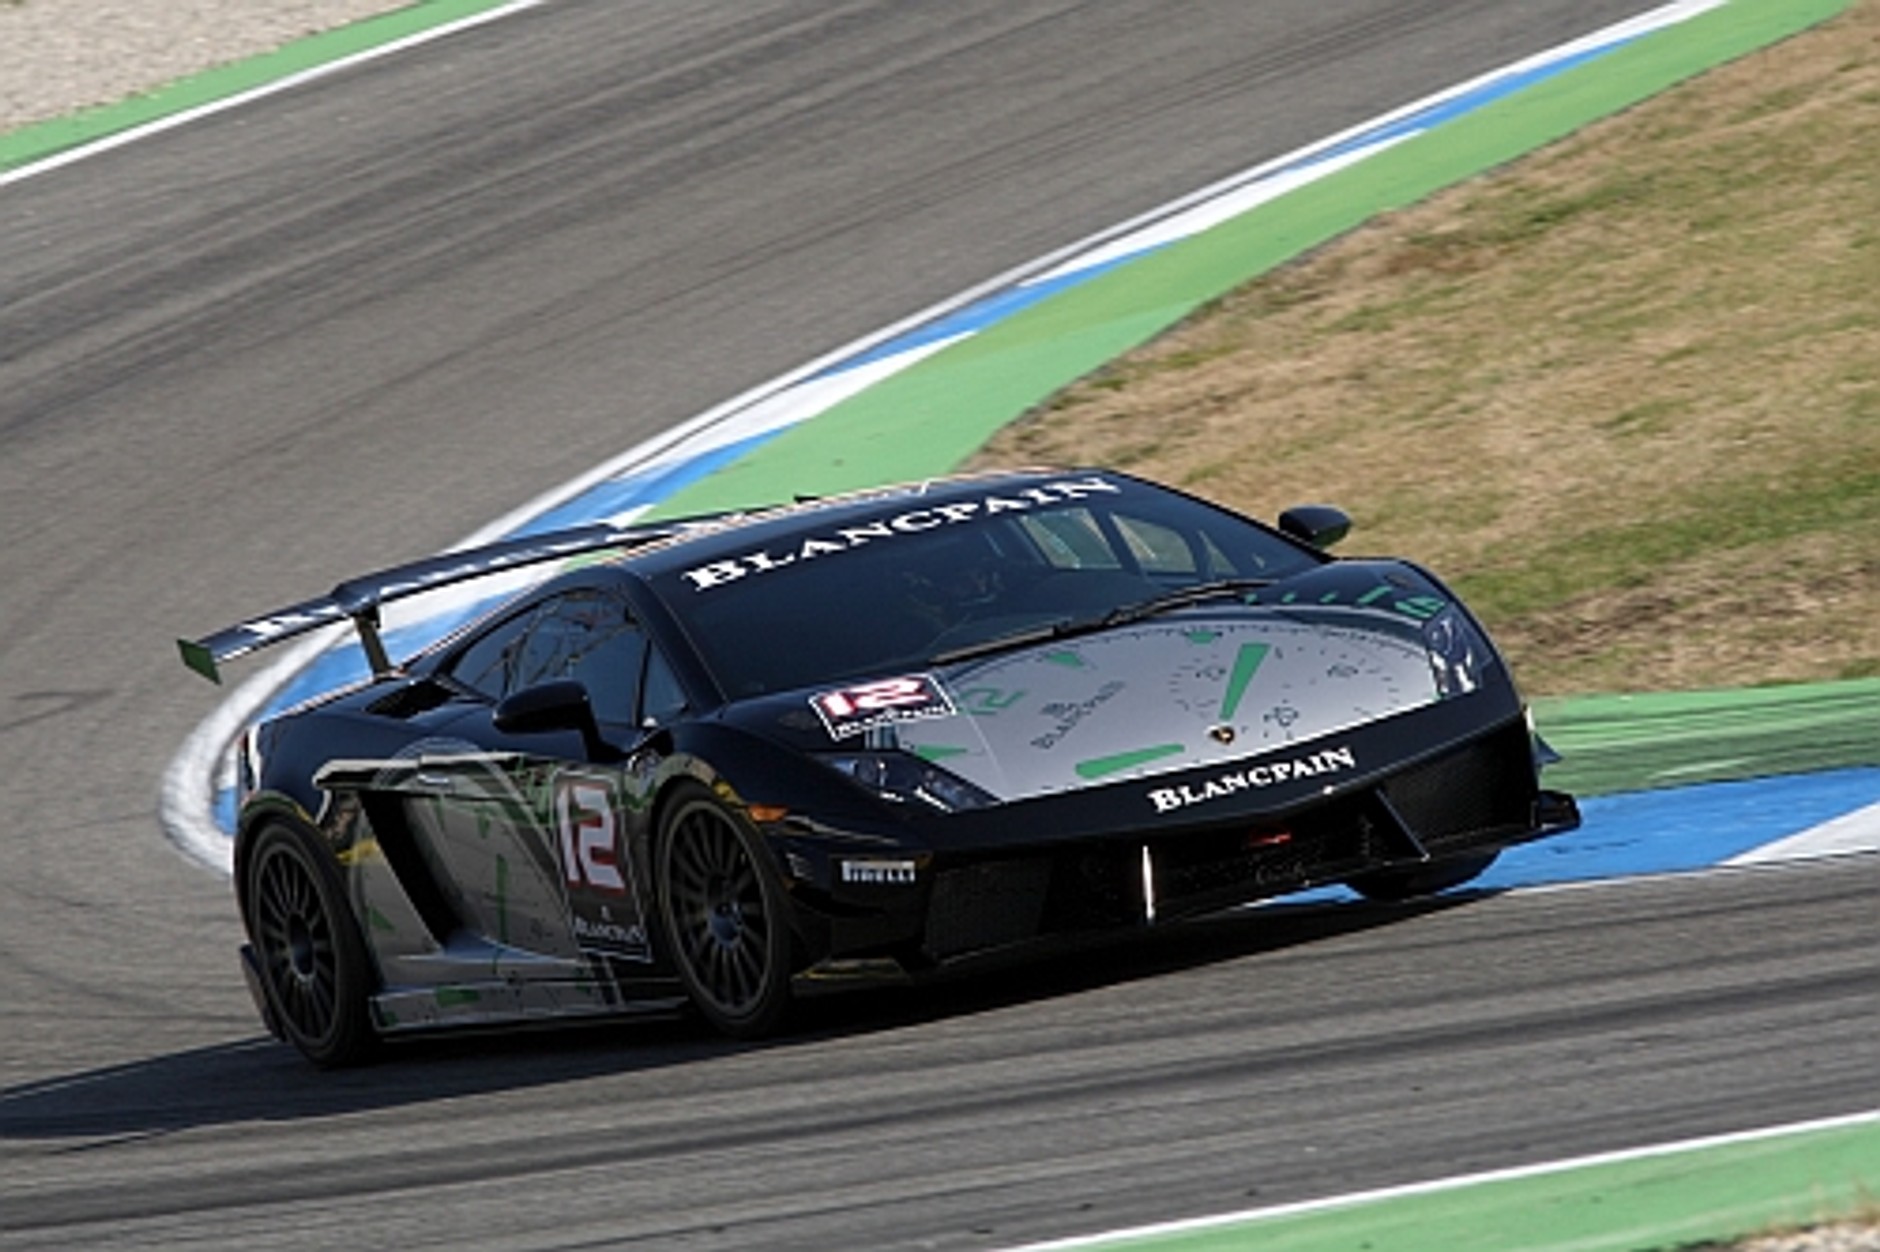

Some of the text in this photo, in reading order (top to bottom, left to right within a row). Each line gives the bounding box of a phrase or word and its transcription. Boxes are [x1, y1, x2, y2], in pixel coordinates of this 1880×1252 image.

[683, 477, 1119, 591] BLANCPAIN
[823, 678, 933, 717] 12
[1148, 746, 1356, 813] BLANCPAIN
[557, 784, 626, 892] 12
